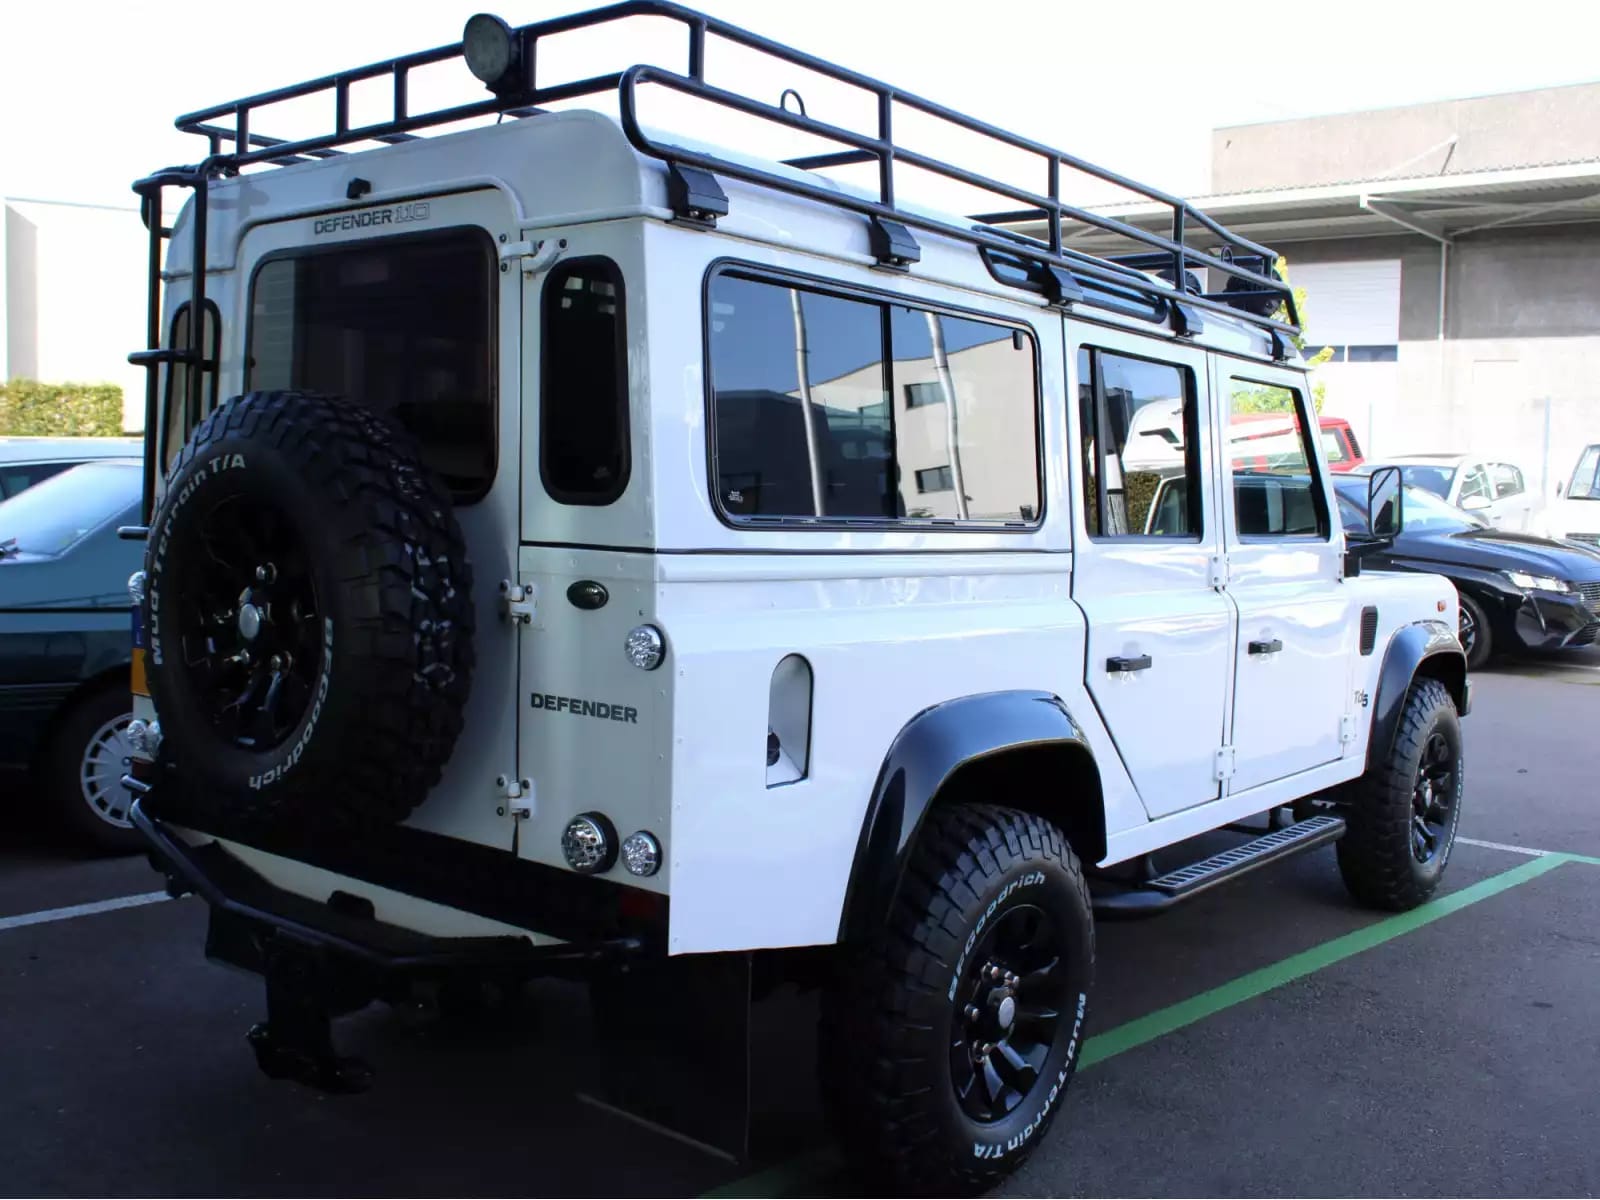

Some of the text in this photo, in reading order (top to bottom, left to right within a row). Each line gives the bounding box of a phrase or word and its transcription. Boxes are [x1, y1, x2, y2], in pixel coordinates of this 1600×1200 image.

[314, 209, 393, 235] DEFENDER
[208, 453, 247, 474] T/A
[530, 692, 638, 724] DEFENDER
[973, 1143, 1005, 1160] T/A
